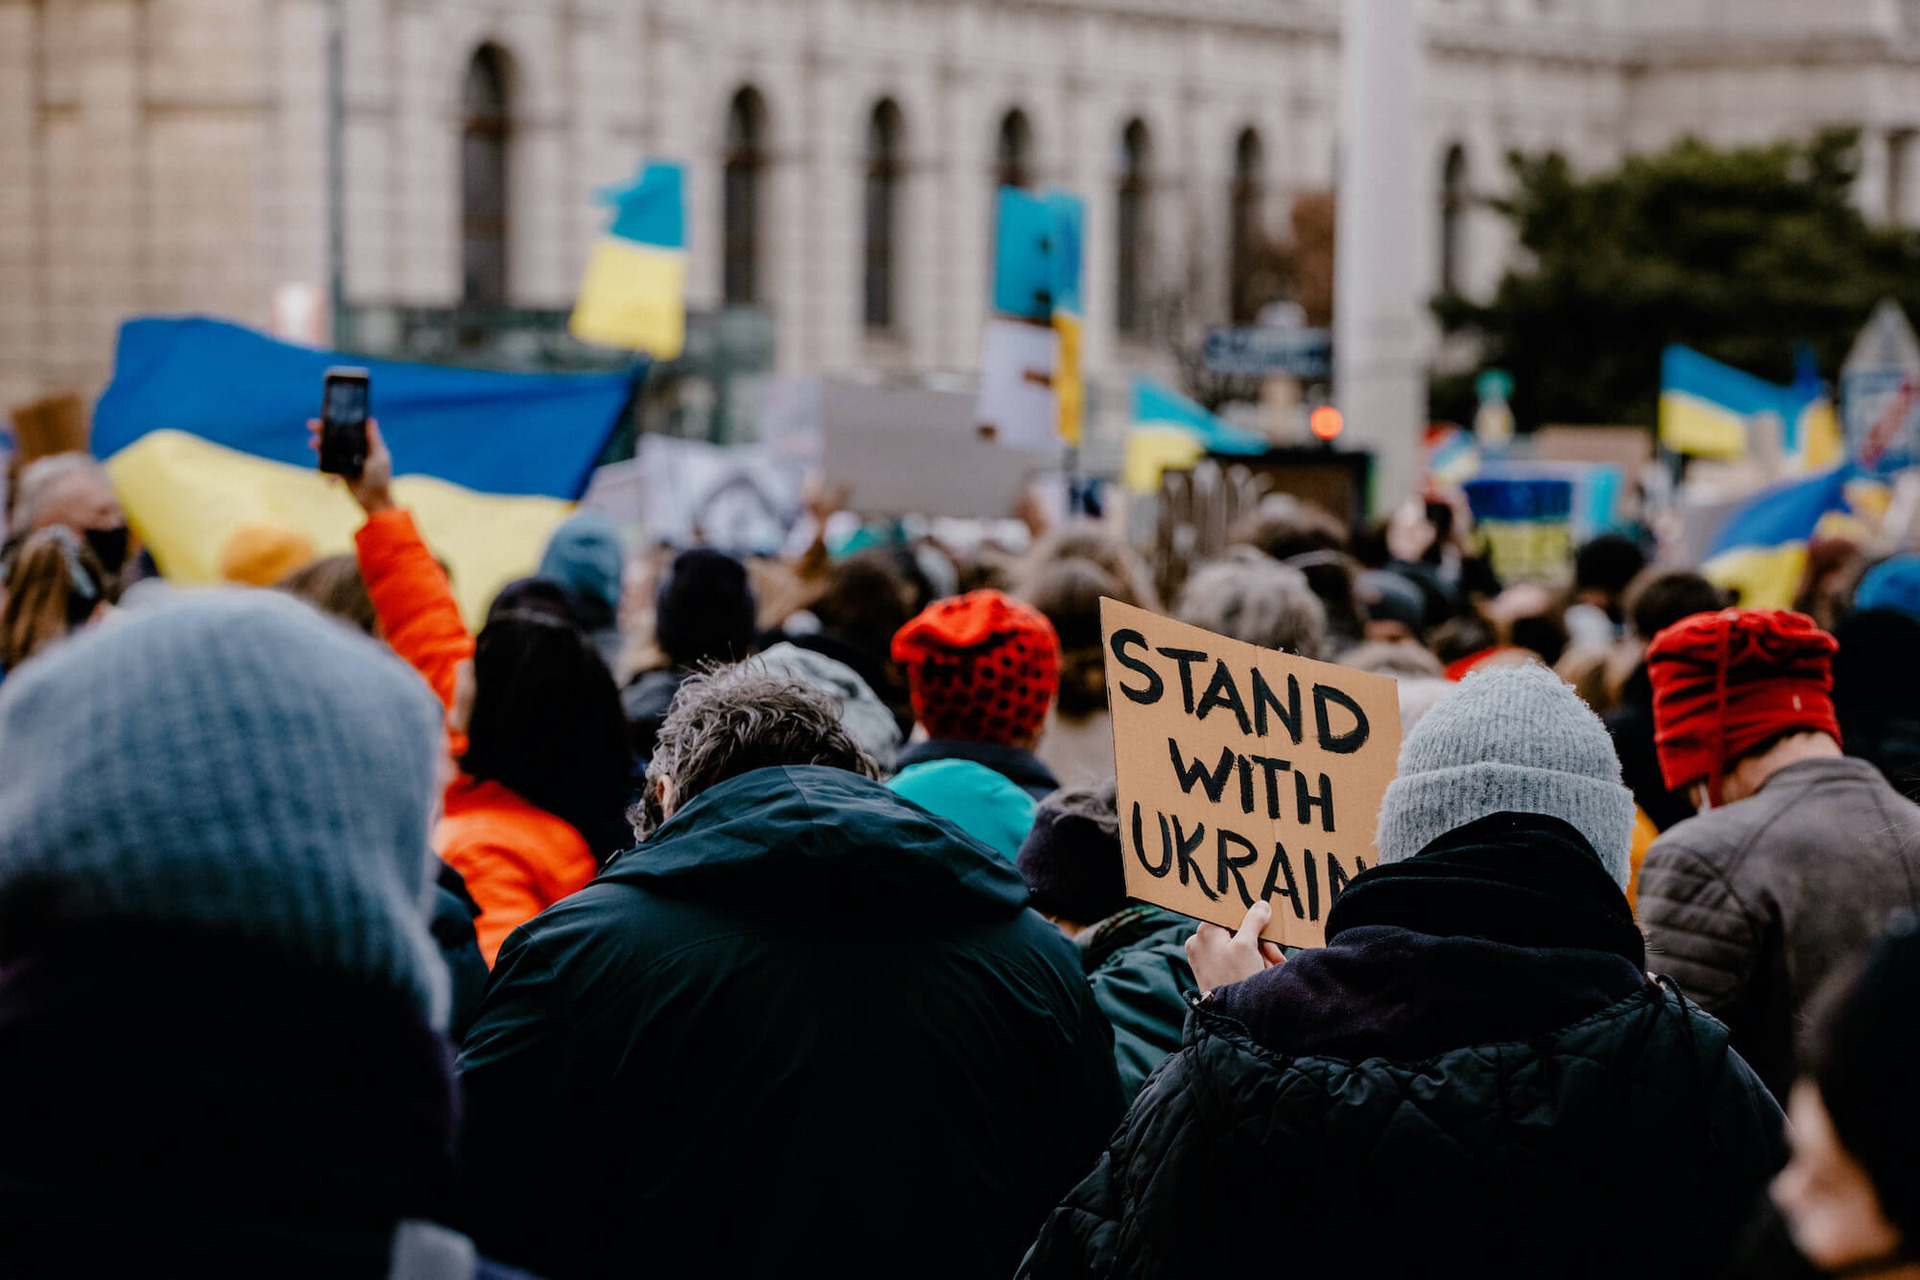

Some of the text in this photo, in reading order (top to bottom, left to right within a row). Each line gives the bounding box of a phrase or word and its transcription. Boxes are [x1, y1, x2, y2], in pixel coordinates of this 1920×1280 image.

[1110, 629, 1370, 753] STAND
[1168, 738, 1335, 832] WITH
[1132, 801, 1379, 922] UKRAIN
